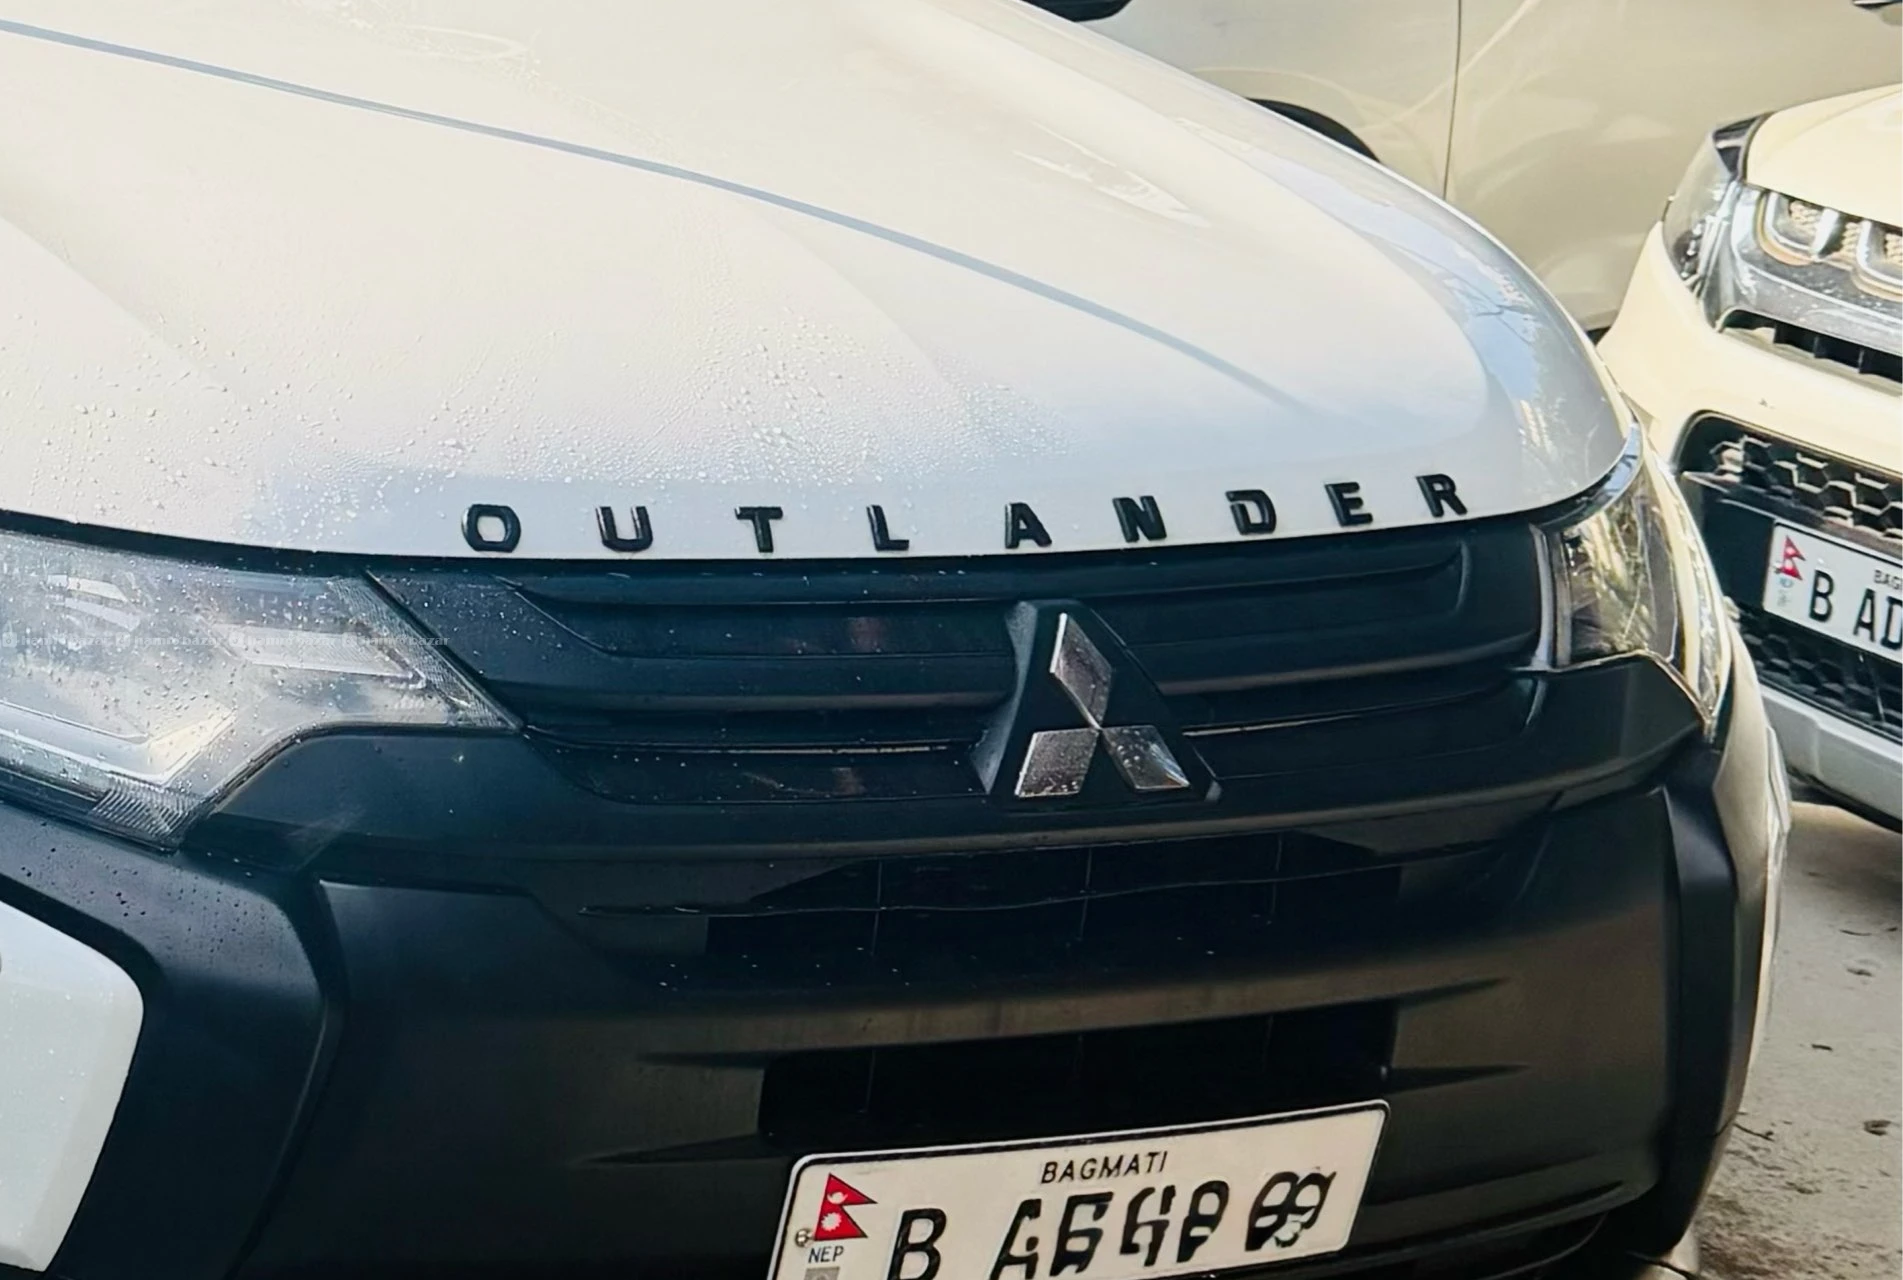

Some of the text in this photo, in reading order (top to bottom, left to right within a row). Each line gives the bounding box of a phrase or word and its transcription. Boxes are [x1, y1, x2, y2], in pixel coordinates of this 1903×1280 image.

[461, 473, 1468, 553] OUTLANDER
[1809, 569, 1835, 622] B
[1041, 1150, 1169, 1185] BAGMATI
[808, 1245, 845, 1264] NEP
